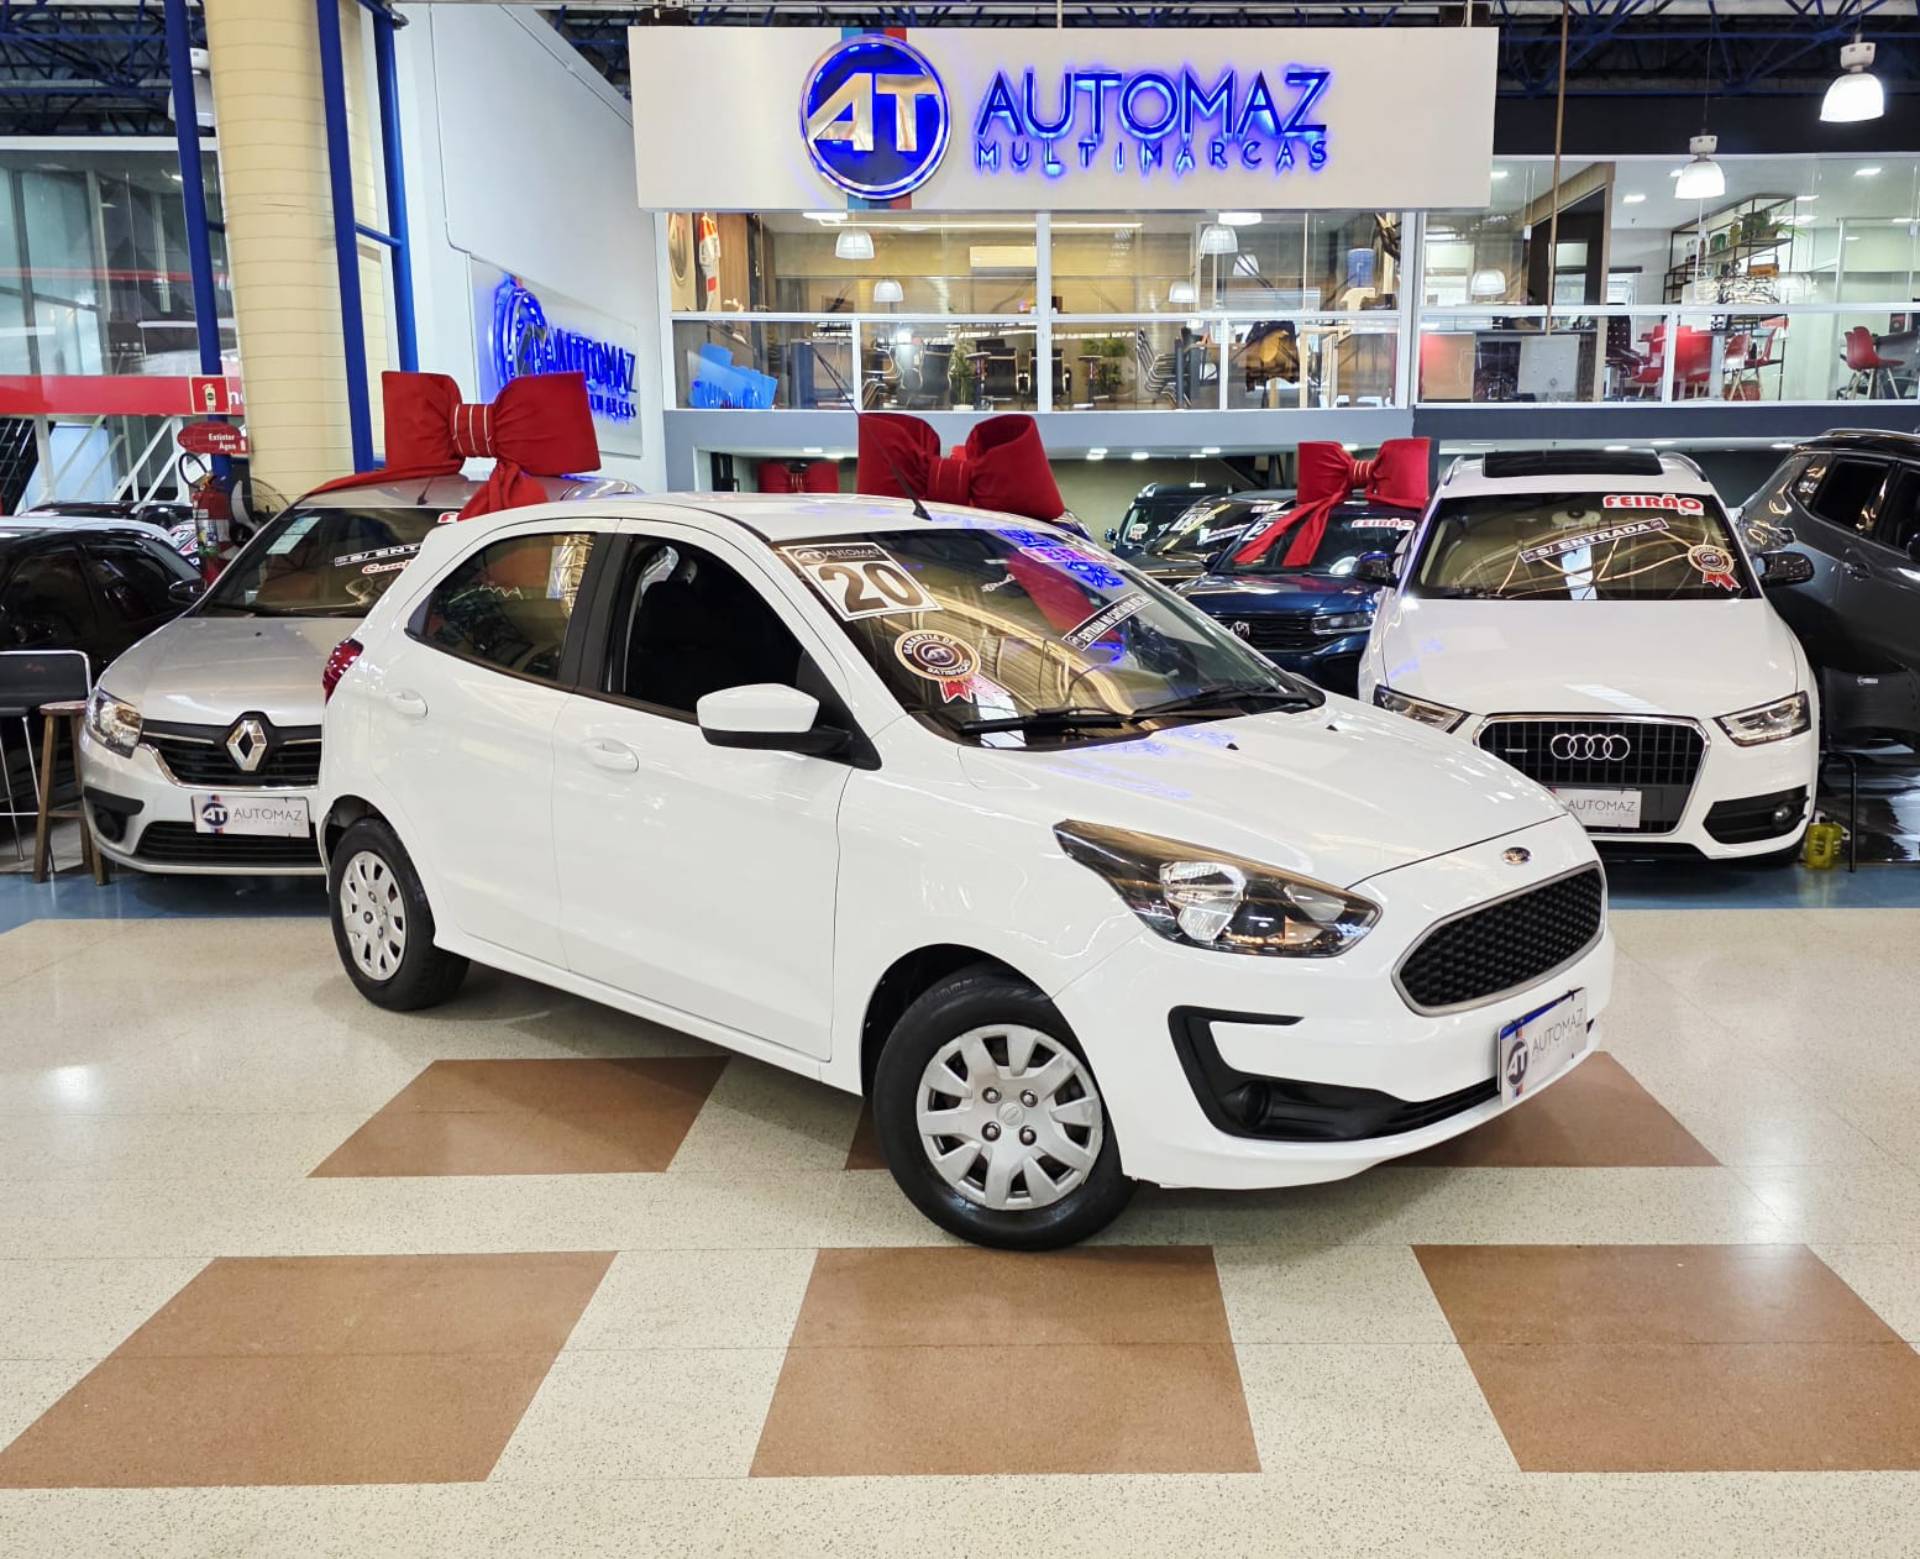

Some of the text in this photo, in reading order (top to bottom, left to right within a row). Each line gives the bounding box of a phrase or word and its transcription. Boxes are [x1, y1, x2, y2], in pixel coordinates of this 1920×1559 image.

[807, 72, 941, 152] AT
[977, 69, 1331, 136] AUTOMAZ
[977, 140, 1328, 168] MULTIMARCAS
[1604, 494, 1702, 511] FEIRÃO
[1558, 523, 1650, 549] ENTRADA
[818, 562, 924, 613] 20
[234, 807, 303, 821] AUTOMAZ
[1567, 799, 1637, 813] AUTOMAZ
[1532, 1007, 1584, 1057] AUTOMAZ
